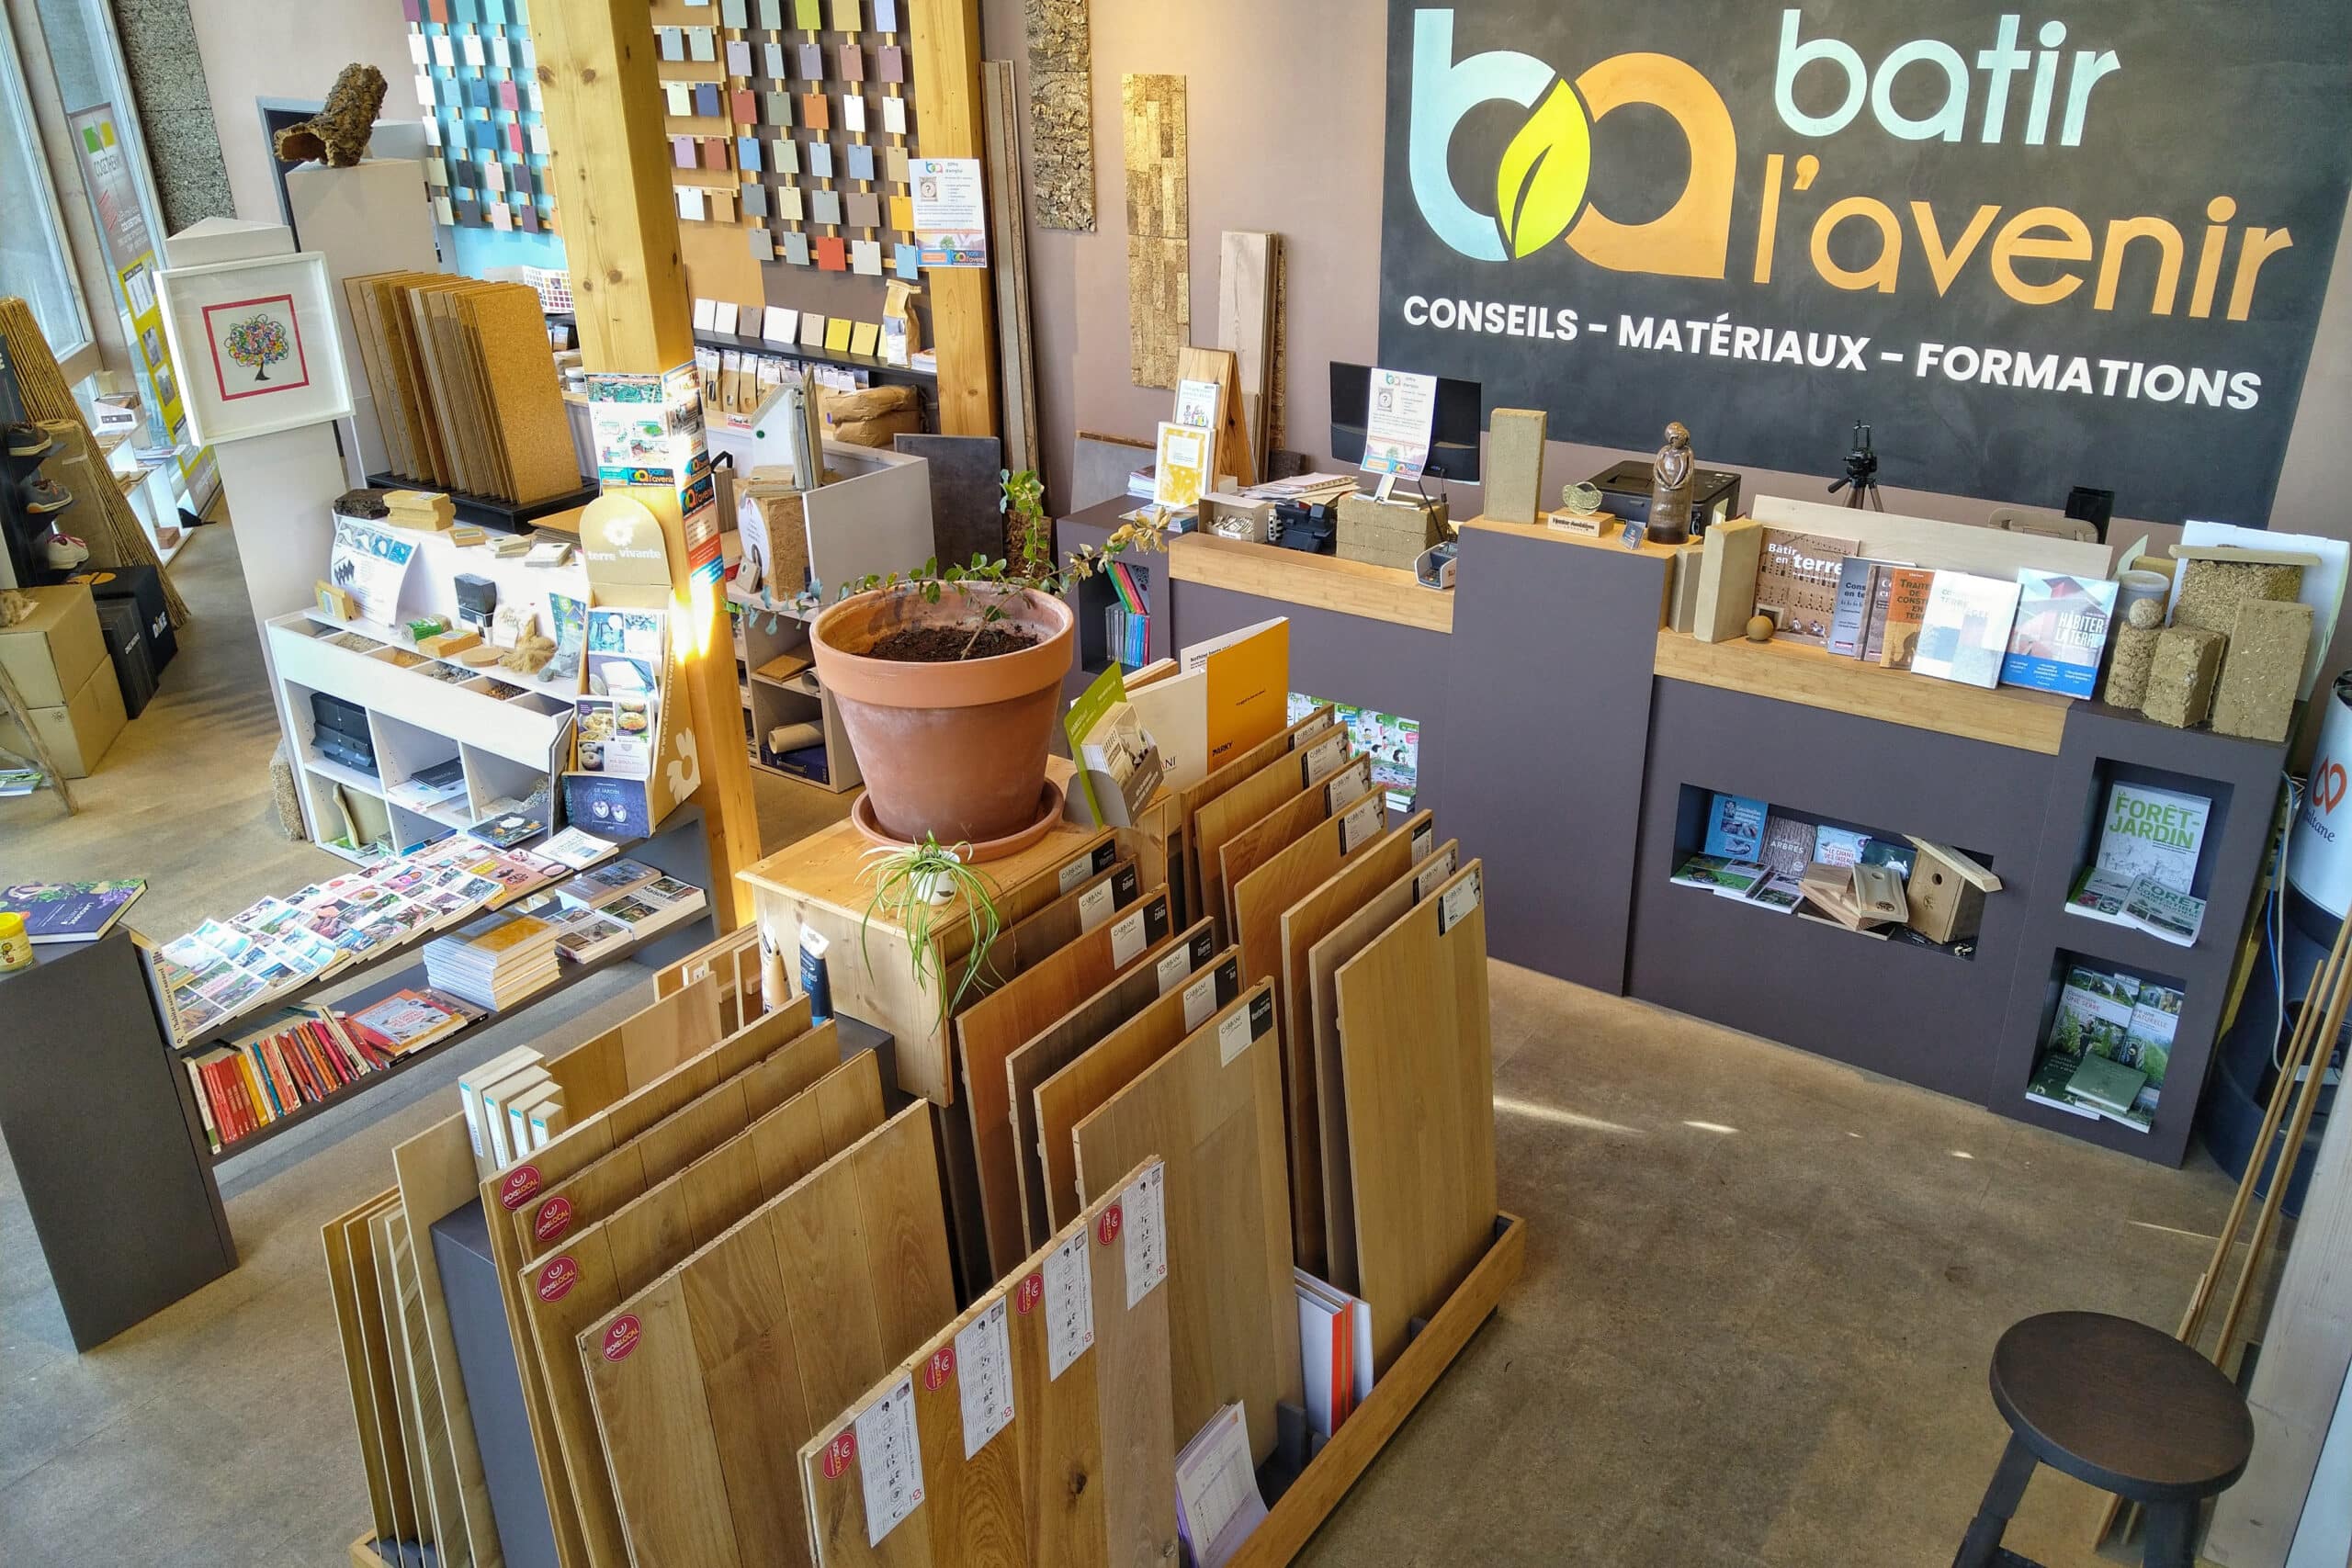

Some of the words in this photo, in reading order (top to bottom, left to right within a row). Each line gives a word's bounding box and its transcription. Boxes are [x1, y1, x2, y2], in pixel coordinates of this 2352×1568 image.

[1774, 7, 2121, 147] batir
[1752, 153, 2294, 322] l'avenir
[1402, 294, 1579, 343] CONSEILS
[1618, 312, 1871, 372] MATÉRIAUX
[1916, 341, 2262, 411] FORMATIONS
[588, 551, 616, 561] terre
[618, 547, 662, 559] vivante
[1768, 543, 1798, 556] Bâtir
[1775, 555, 1789, 564] en
[1844, 590, 1855, 598] en
[2058, 611, 2105, 634] HABITER
[2055, 627, 2067, 642] LA
[1212, 741, 1234, 758] PARKY
[2115, 795, 2200, 829] FORÊT-
[2109, 816, 2195, 850] JARDIN
[1770, 840, 1805, 854] ARBRES
